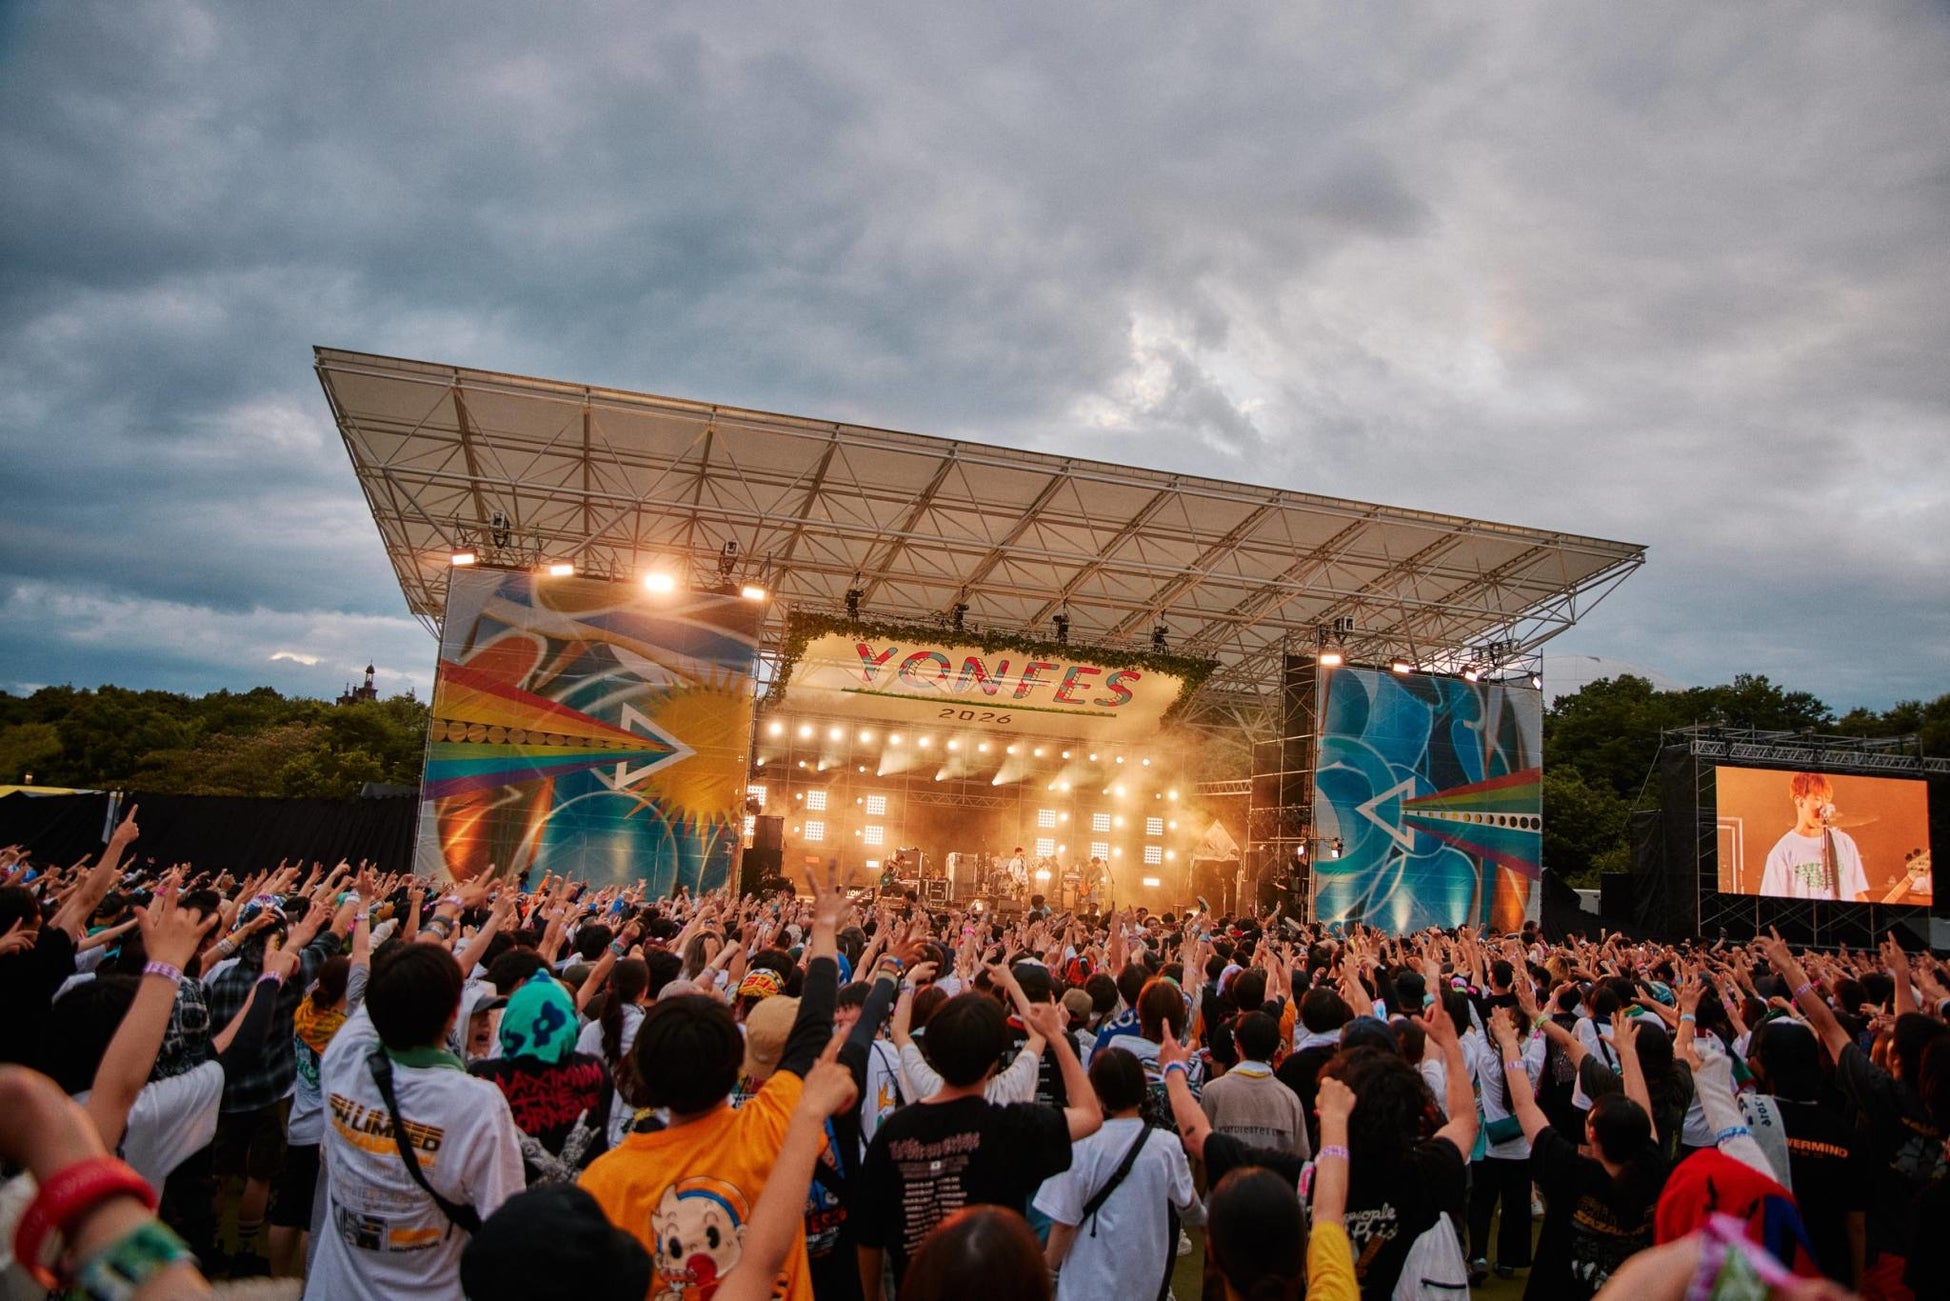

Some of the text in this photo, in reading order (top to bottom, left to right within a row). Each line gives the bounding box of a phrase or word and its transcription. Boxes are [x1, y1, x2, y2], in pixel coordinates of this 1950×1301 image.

[856, 642, 1142, 707] YONFES
[938, 708, 1012, 725] 2026
[846, 889, 873, 899] YONS
